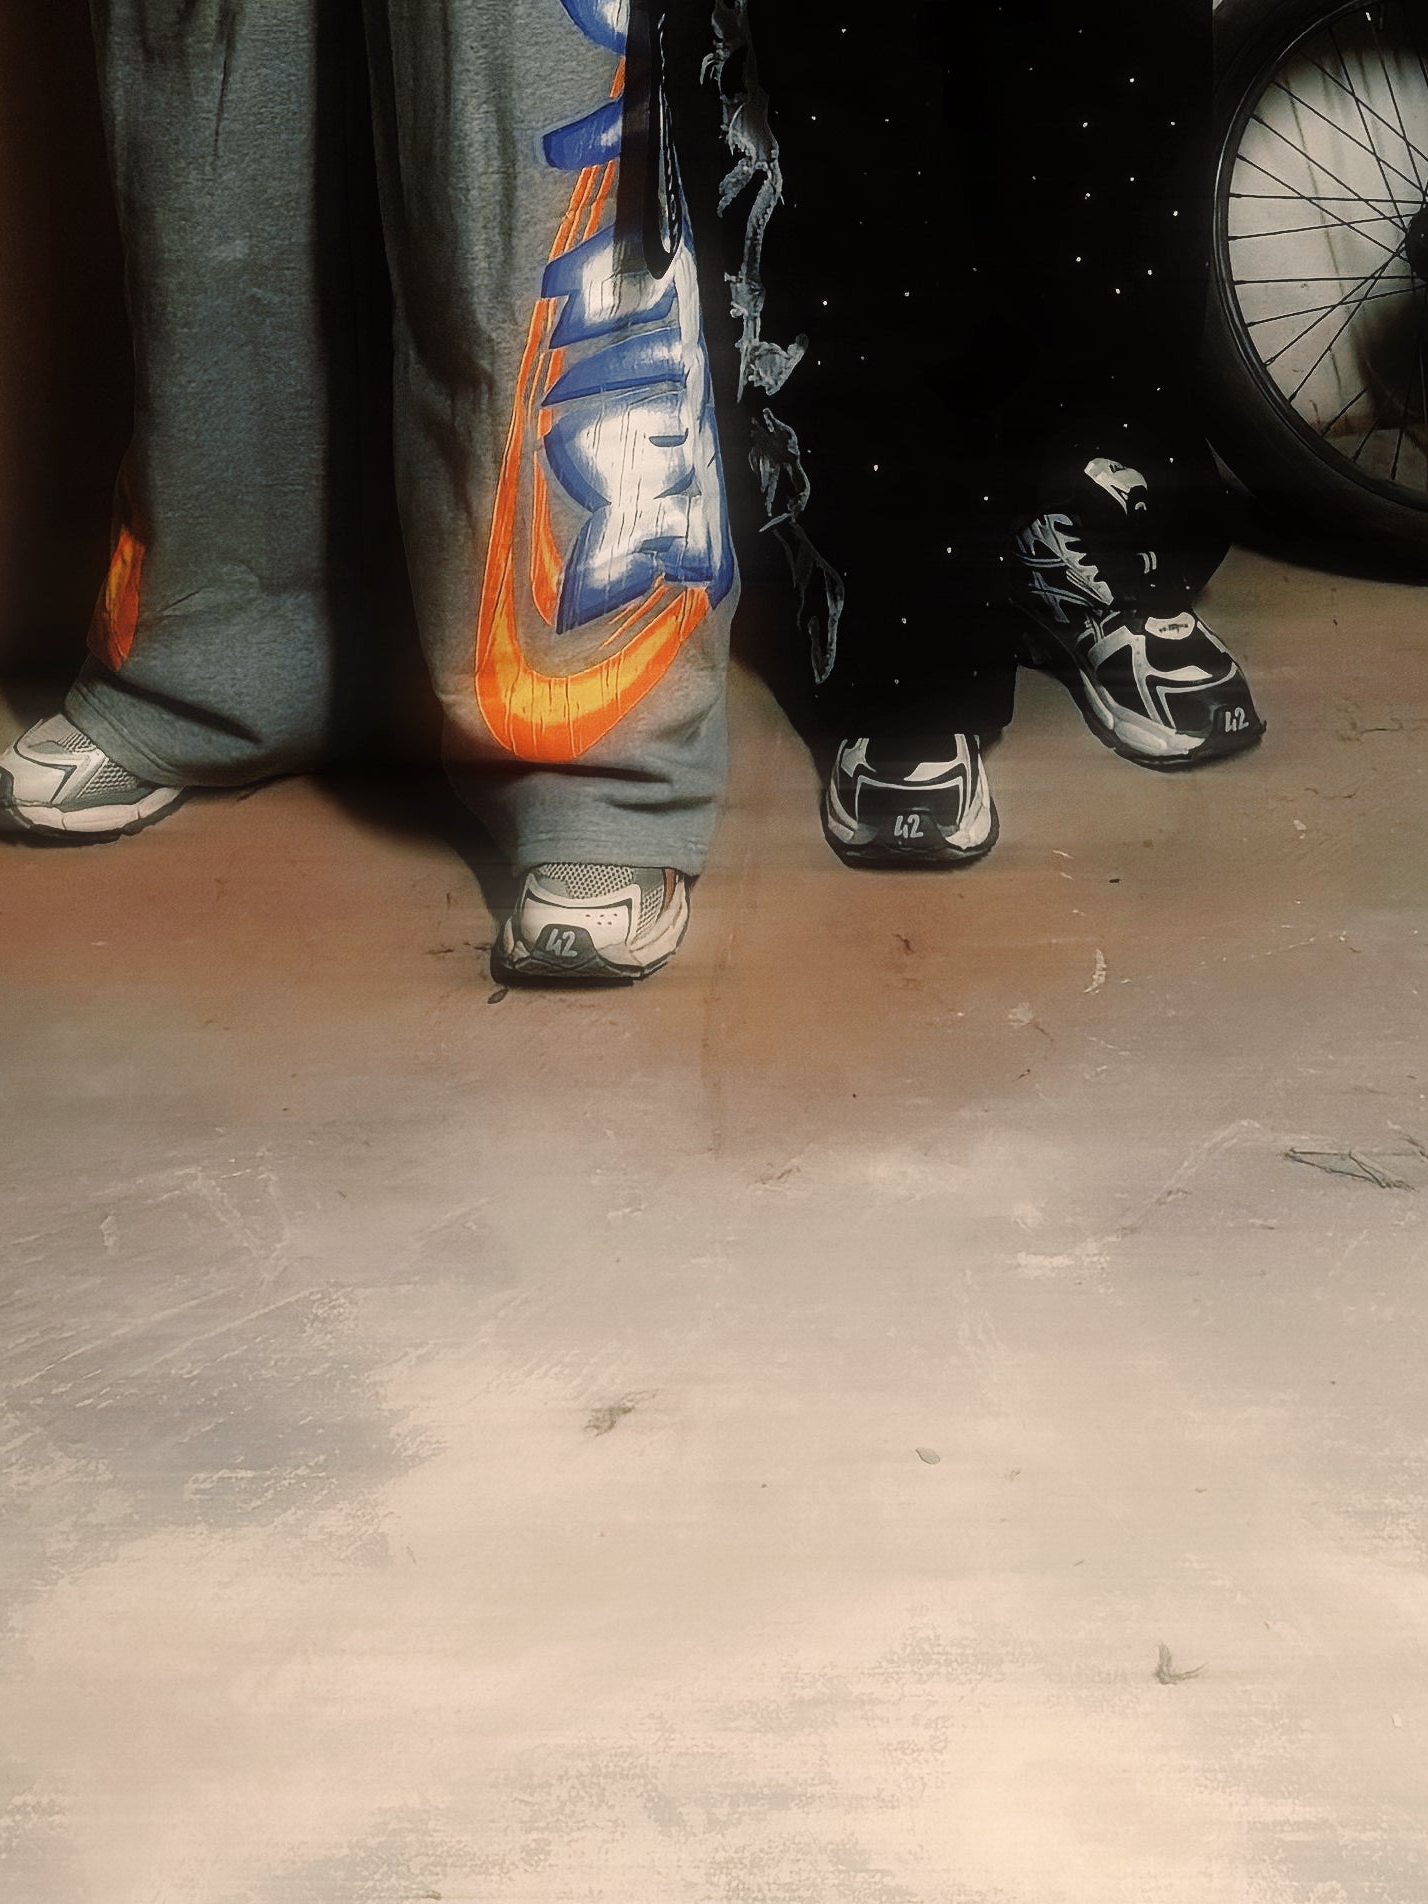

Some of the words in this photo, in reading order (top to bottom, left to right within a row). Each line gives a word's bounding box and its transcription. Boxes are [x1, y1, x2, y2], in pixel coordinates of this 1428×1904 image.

[1224, 707, 1250, 733] 42
[893, 814, 924, 839] 42
[545, 928, 579, 958] 42
